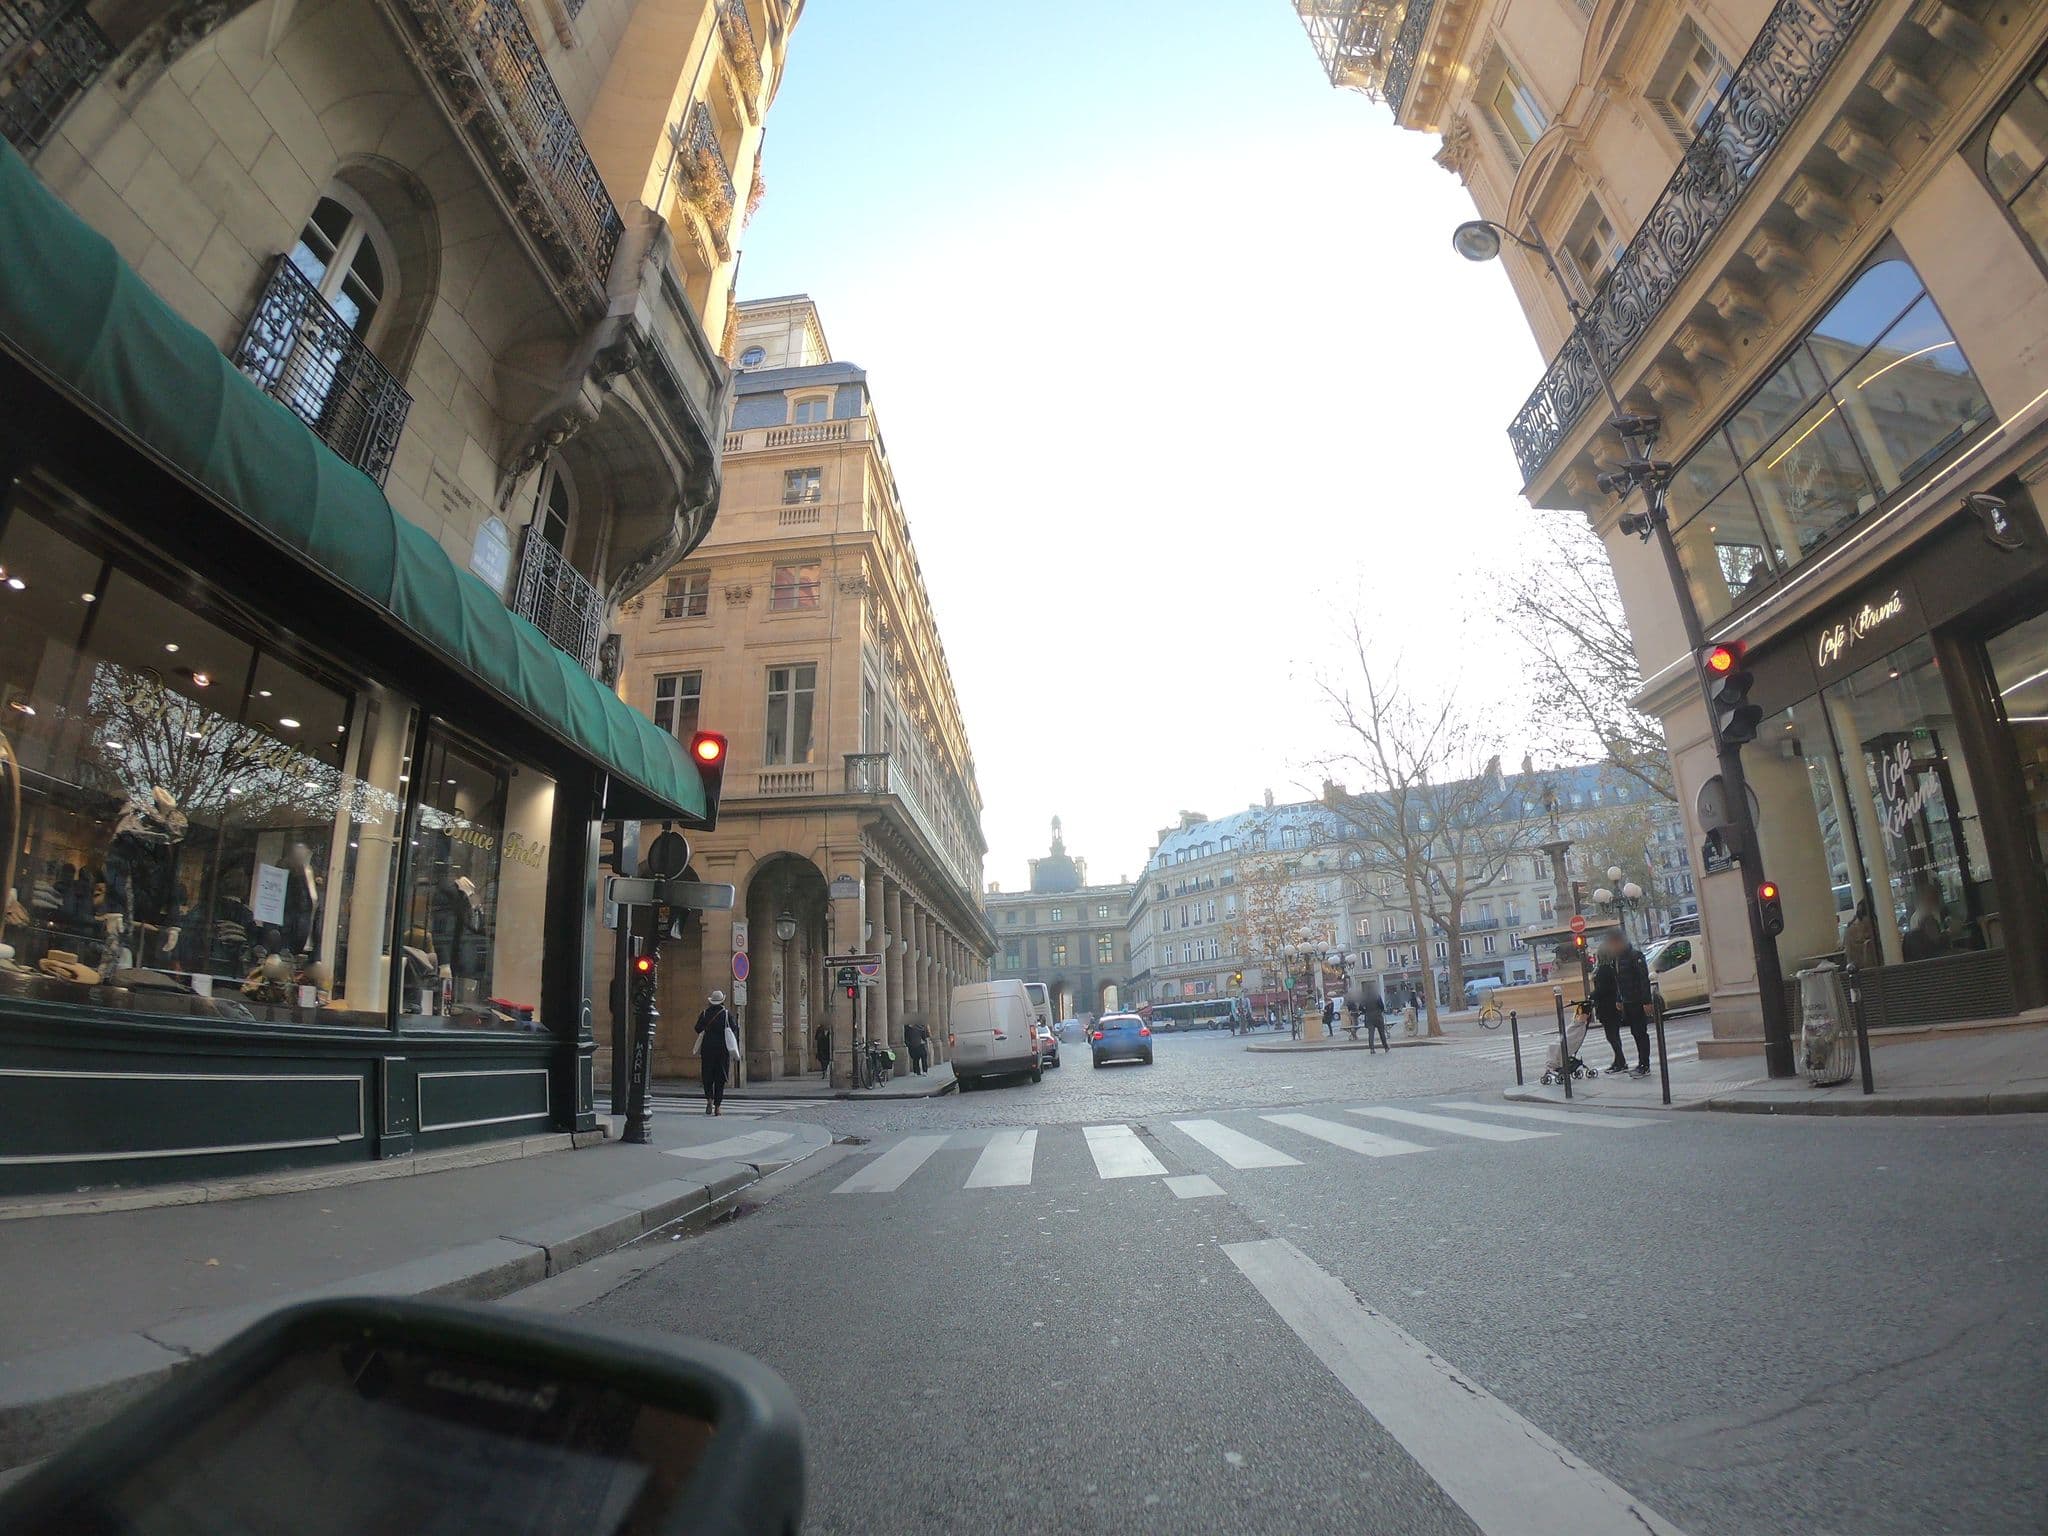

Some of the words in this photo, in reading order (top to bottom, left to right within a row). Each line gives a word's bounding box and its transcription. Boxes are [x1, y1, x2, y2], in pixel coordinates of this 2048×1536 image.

[1819, 625, 1845, 667] Café
[1849, 590, 1902, 648] Kitsuné
[1881, 740, 1912, 802] Café
[1882, 766, 1939, 851] Kitsuné
[503, 831, 546, 869] Field
